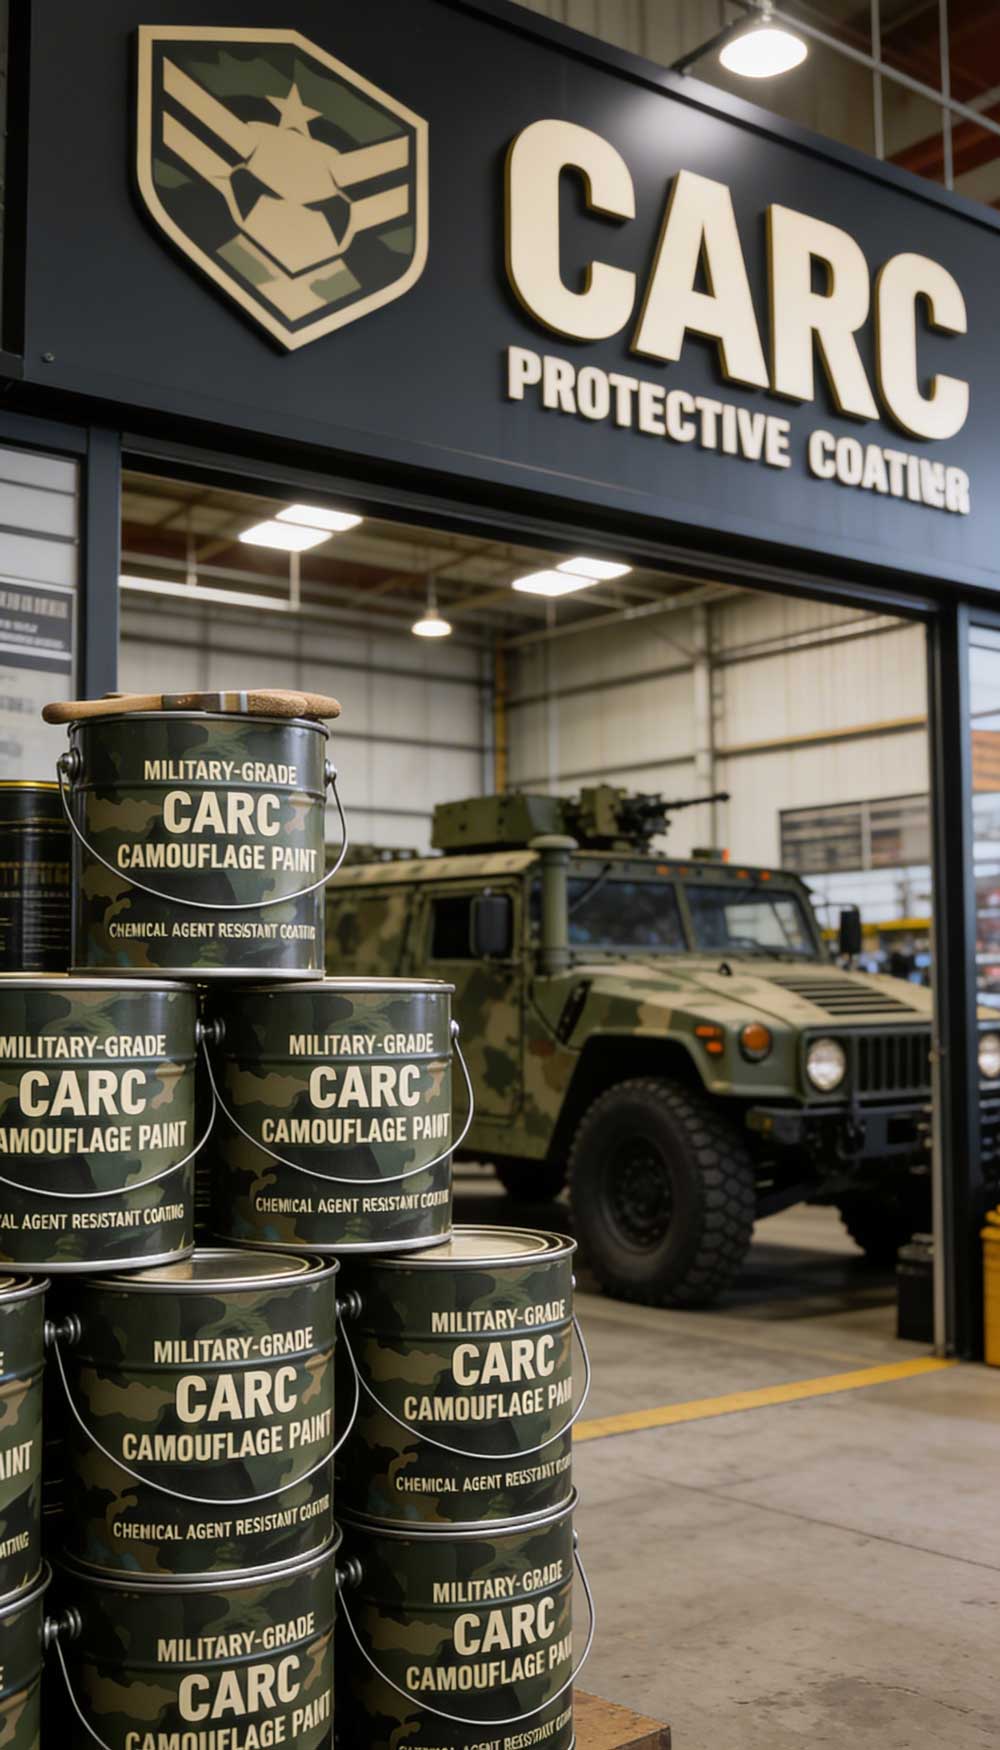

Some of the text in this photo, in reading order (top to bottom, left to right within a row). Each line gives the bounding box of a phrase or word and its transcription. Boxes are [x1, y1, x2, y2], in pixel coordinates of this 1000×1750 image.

[505, 118, 969, 441] CARC
[507, 345, 791, 469] PROTECTIVE
[144, 760, 297, 785] MILITARY-GRADE
[163, 790, 281, 837] CARC
[117, 842, 317, 873] CAMOUFLAGE PAINT
[109, 922, 168, 938] CHEMICAL
[172, 922, 215, 938] AGENT
[0, 1034, 166, 1059] MILITARY-GRADE
[289, 1032, 434, 1056] MILITARY-GRADE
[19, 1069, 146, 1118] CARC
[309, 1064, 420, 1109] CARC
[0, 1121, 187, 1154] AMOUFLAGE PAINT
[262, 1117, 407, 1144] CAMOUFLAGE
[22, 1213, 68, 1230] AGENT
[256, 1196, 312, 1213] CHEMICAL
[317, 1198, 359, 1213] AGENT
[431, 1299, 565, 1334] MILITARY-GRADE
[154, 1326, 314, 1364] MILITARY-GRADE
[452, 1334, 555, 1386] CARC
[175, 1366, 298, 1424] CARC
[404, 1387, 544, 1422] CAMOUFLAGE
[122, 1408, 332, 1463] CAMOUFLAGE PAINT
[0, 1440, 33, 1480] AINT
[396, 1475, 460, 1493] CHEMICAL
[463, 1473, 502, 1493] AGENT
[113, 1521, 183, 1541] CHEMICAL
[186, 1521, 232, 1540] AGENT
[433, 1560, 563, 1604] MILITARY-GRADE
[157, 1612, 315, 1663] MILITARY-GRADE
[454, 1596, 555, 1656] CARC
[178, 1654, 300, 1722] CARC
[406, 1650, 545, 1691] CAMOUFLAGE
[125, 1688, 331, 1750] CAMOUFLAGE PAINT
